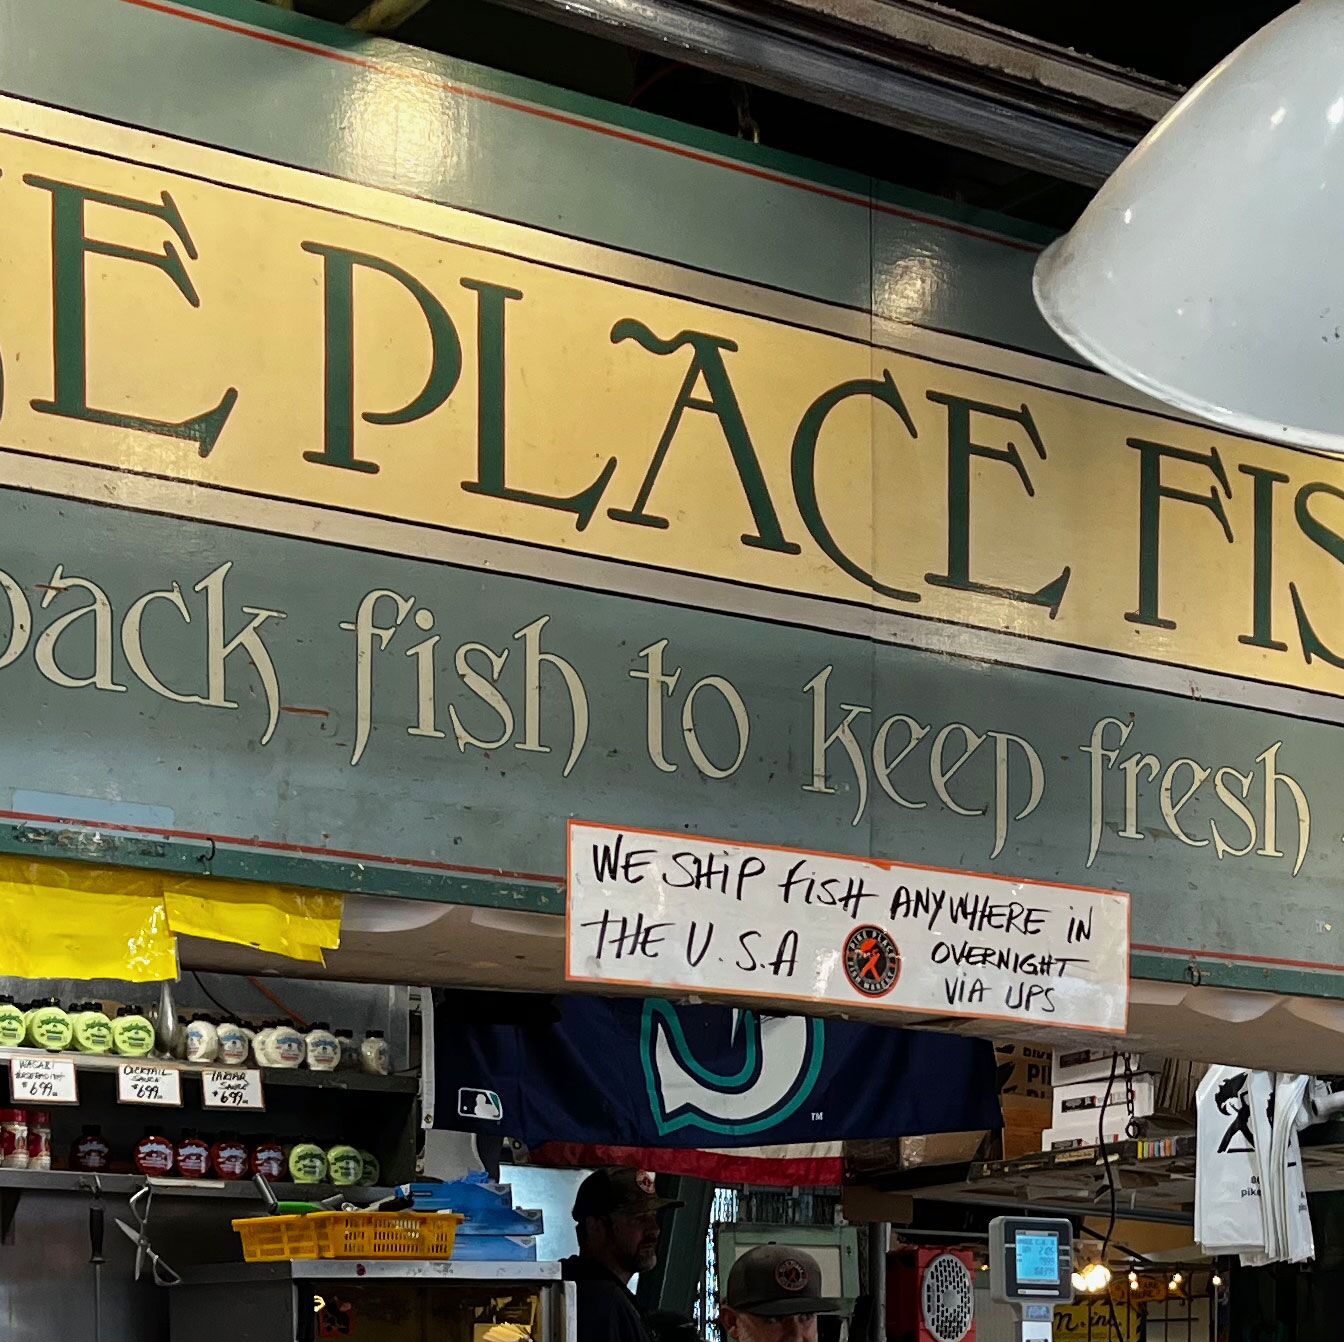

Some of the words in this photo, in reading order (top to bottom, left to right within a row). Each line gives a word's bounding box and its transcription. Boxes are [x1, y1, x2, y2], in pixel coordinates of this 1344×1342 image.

[301, 239, 1072, 621] PLACE
[339, 588, 595, 770] fish
[628, 638, 753, 780] to
[802, 664, 1046, 859] keep
[1078, 710, 1310, 876] fresh
[592, 834, 658, 883] WE
[889, 885, 1053, 935] ANYWHERE
[580, 909, 676, 960] THE
[931, 940, 1090, 978] OVERNIGHT
[1006, 980, 1056, 1012] UPS
